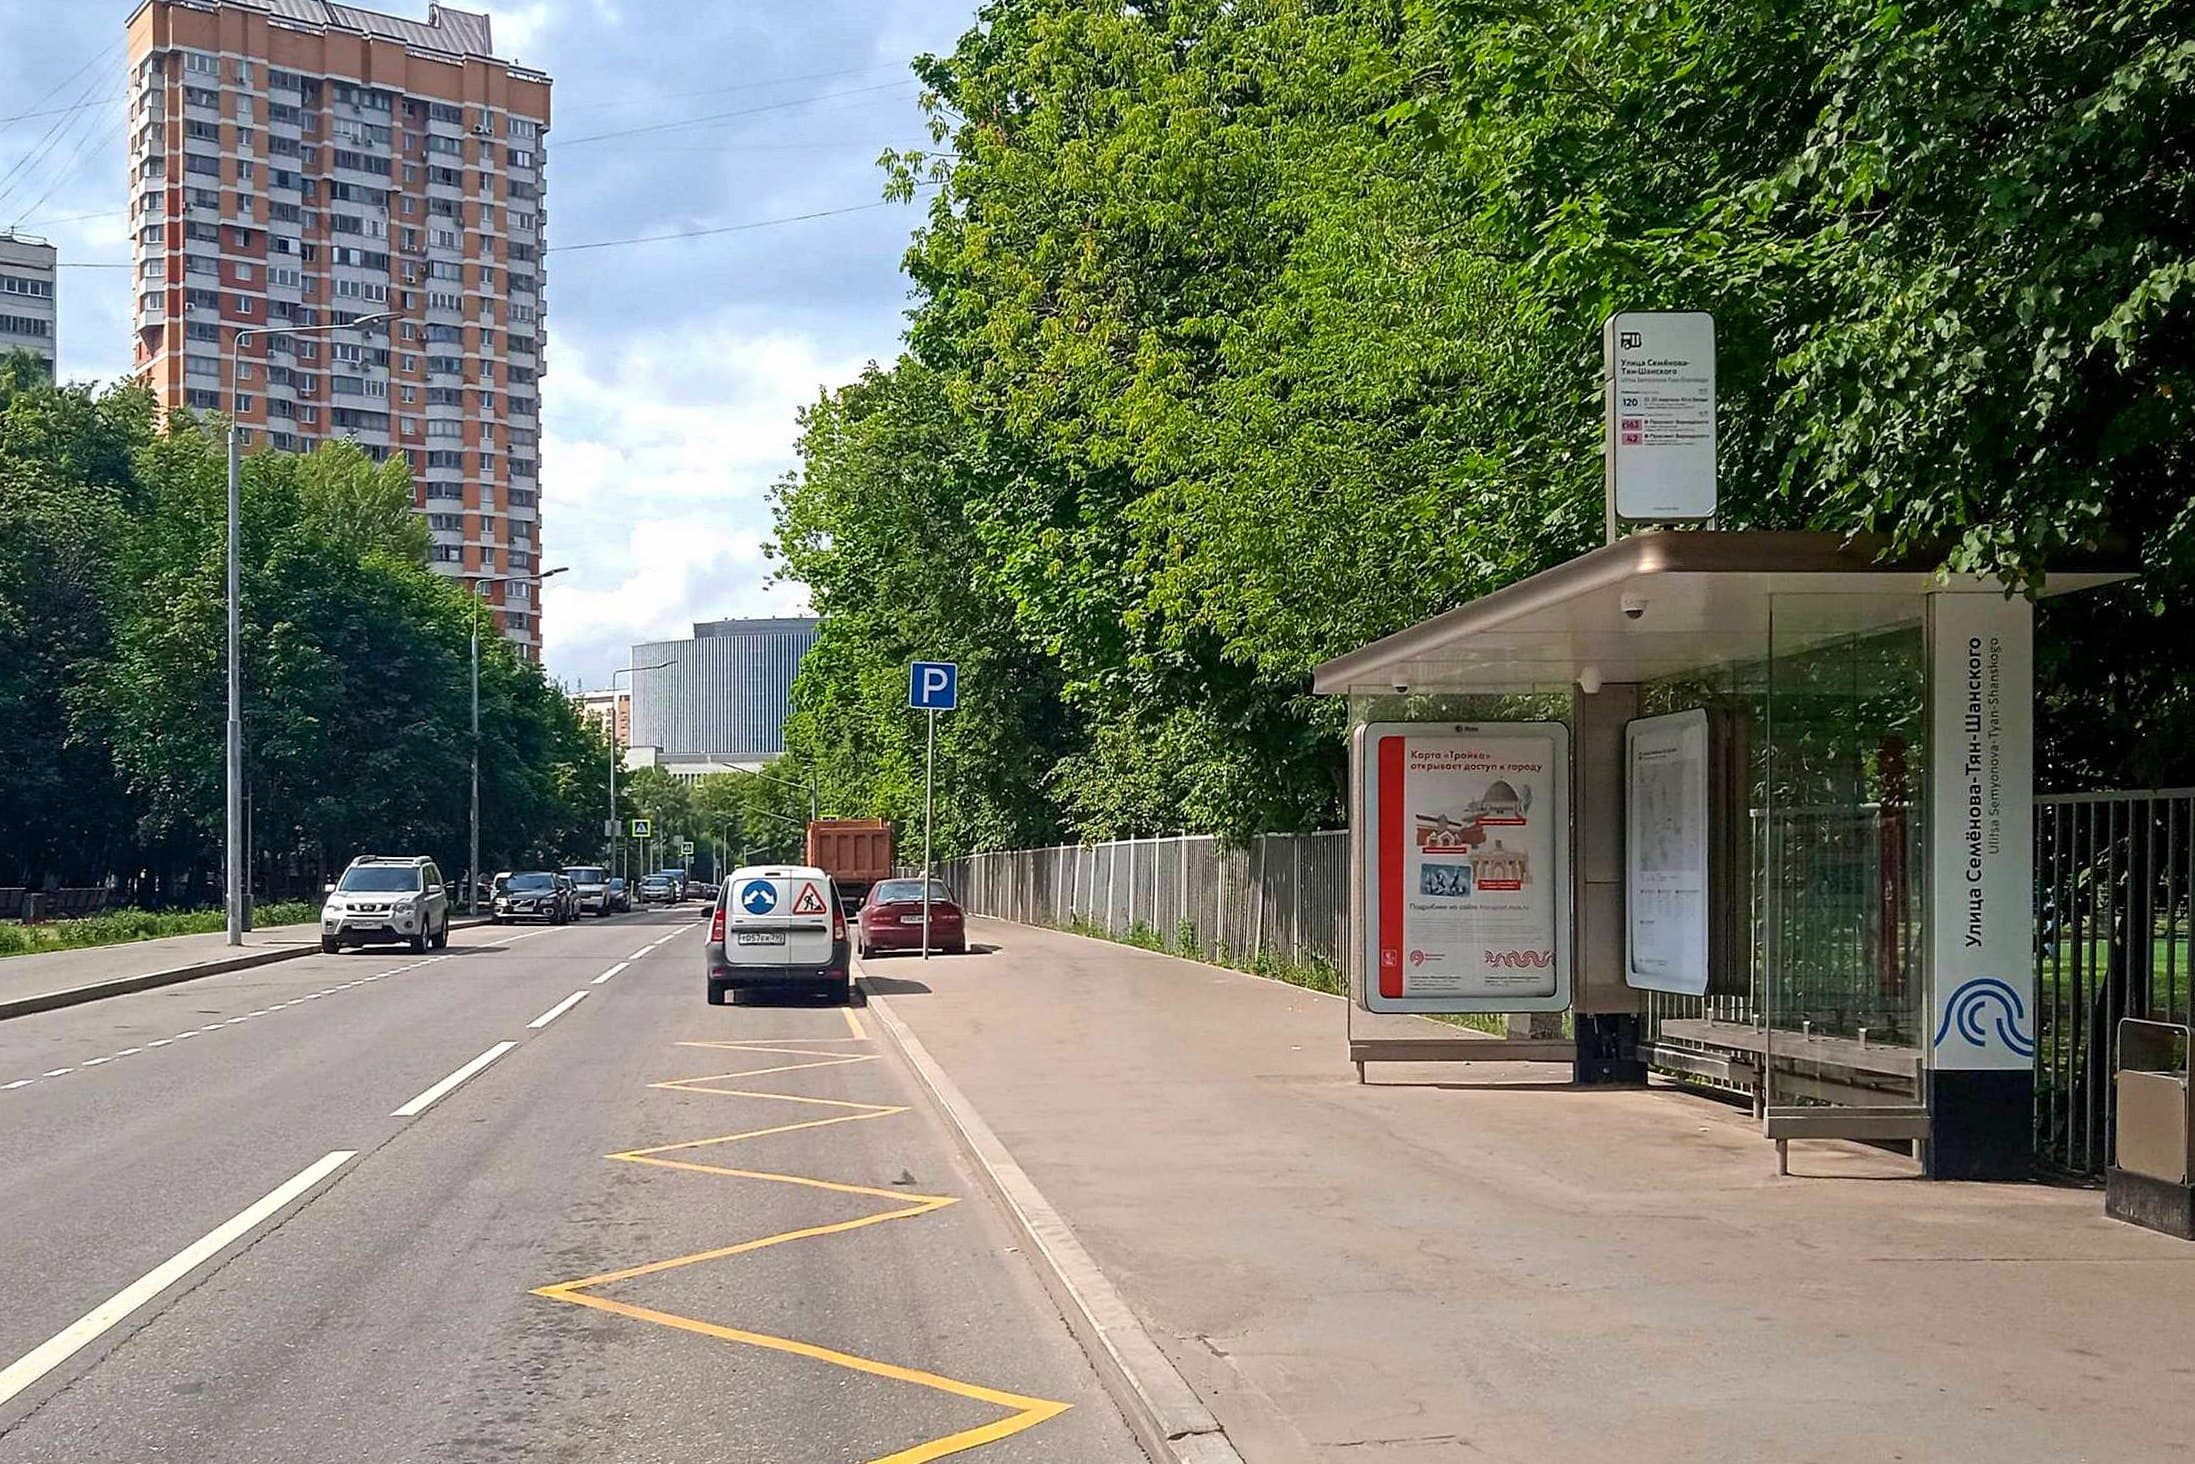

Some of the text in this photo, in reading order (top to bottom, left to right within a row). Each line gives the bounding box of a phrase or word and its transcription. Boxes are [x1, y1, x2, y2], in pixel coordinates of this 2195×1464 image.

[1623, 398, 1637, 407] 120
[923, 667, 948, 703] P
[1988, 638, 2001, 816] Semyonova-Tyan-Shanskogo
[1411, 750, 1441, 760] Карта
[1410, 763, 1461, 772] открывает
[1464, 763, 1497, 772] доступ
[1508, 763, 1542, 773] городу
[1965, 637, 1984, 948] Улица Семёнова-Тян-Шанского
